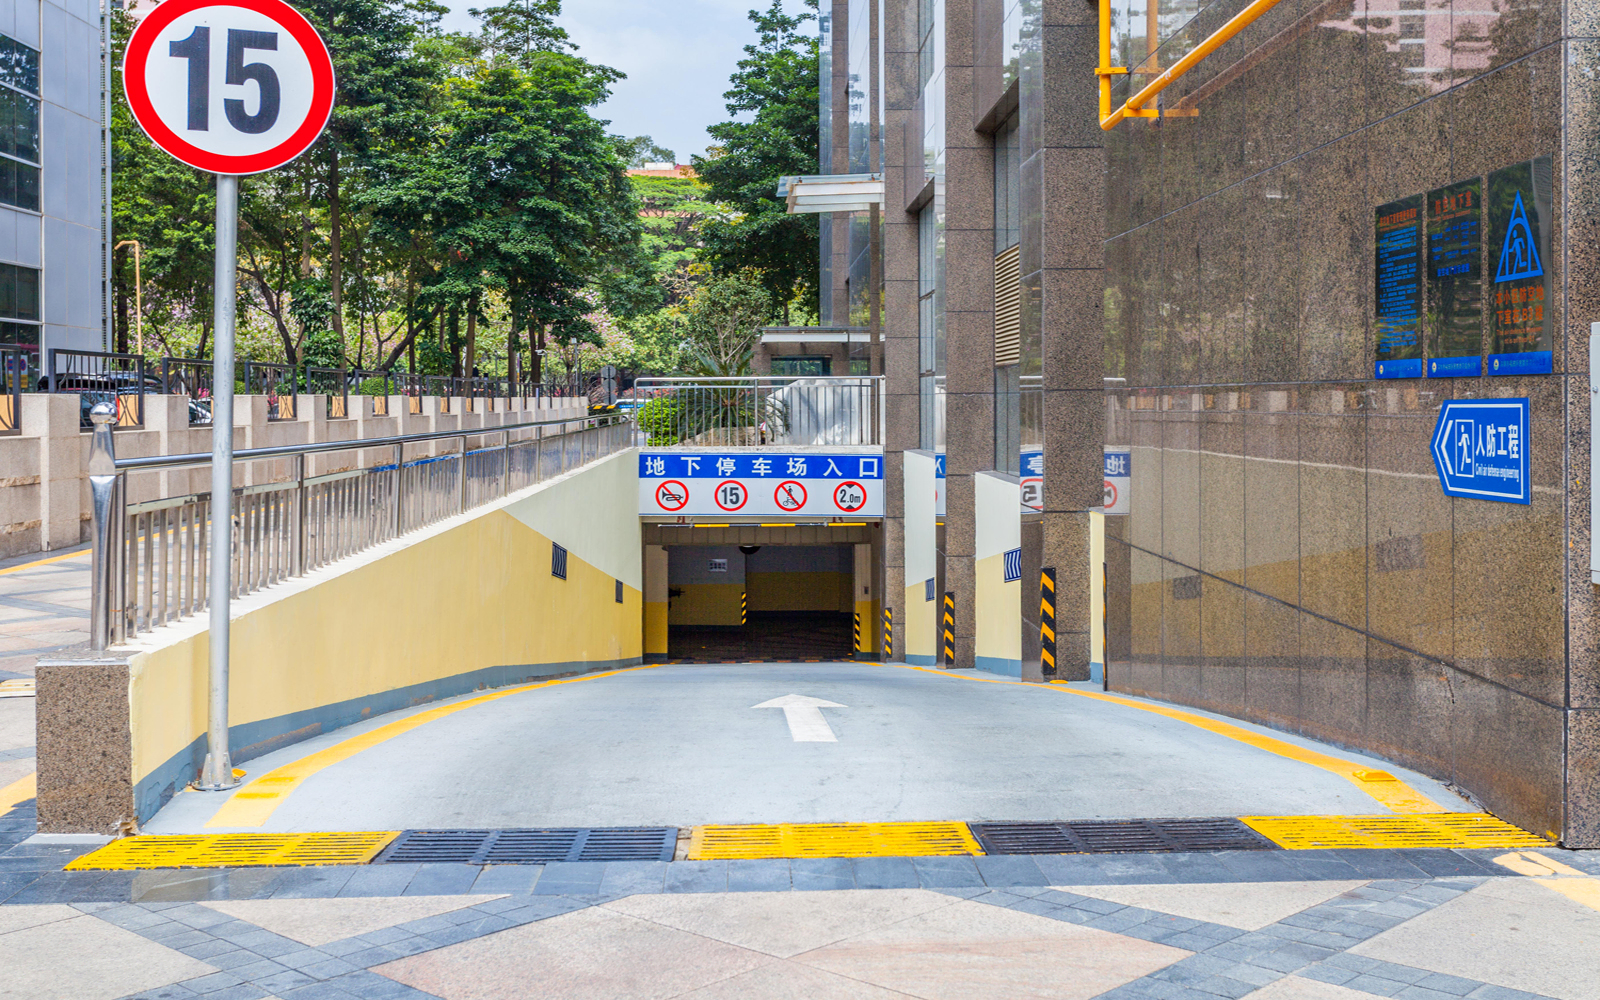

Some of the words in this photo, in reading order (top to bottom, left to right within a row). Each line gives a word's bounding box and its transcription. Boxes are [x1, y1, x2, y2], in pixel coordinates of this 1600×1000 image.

[169, 26, 281, 134] 15
[1496, 284, 1544, 305] 本小区防空地
[1476, 423, 1519, 459] 人防工程
[646, 457, 878, 477] 地下停车场入口
[721, 487, 740, 505] 15
[840, 489, 861, 504] 2.0m
